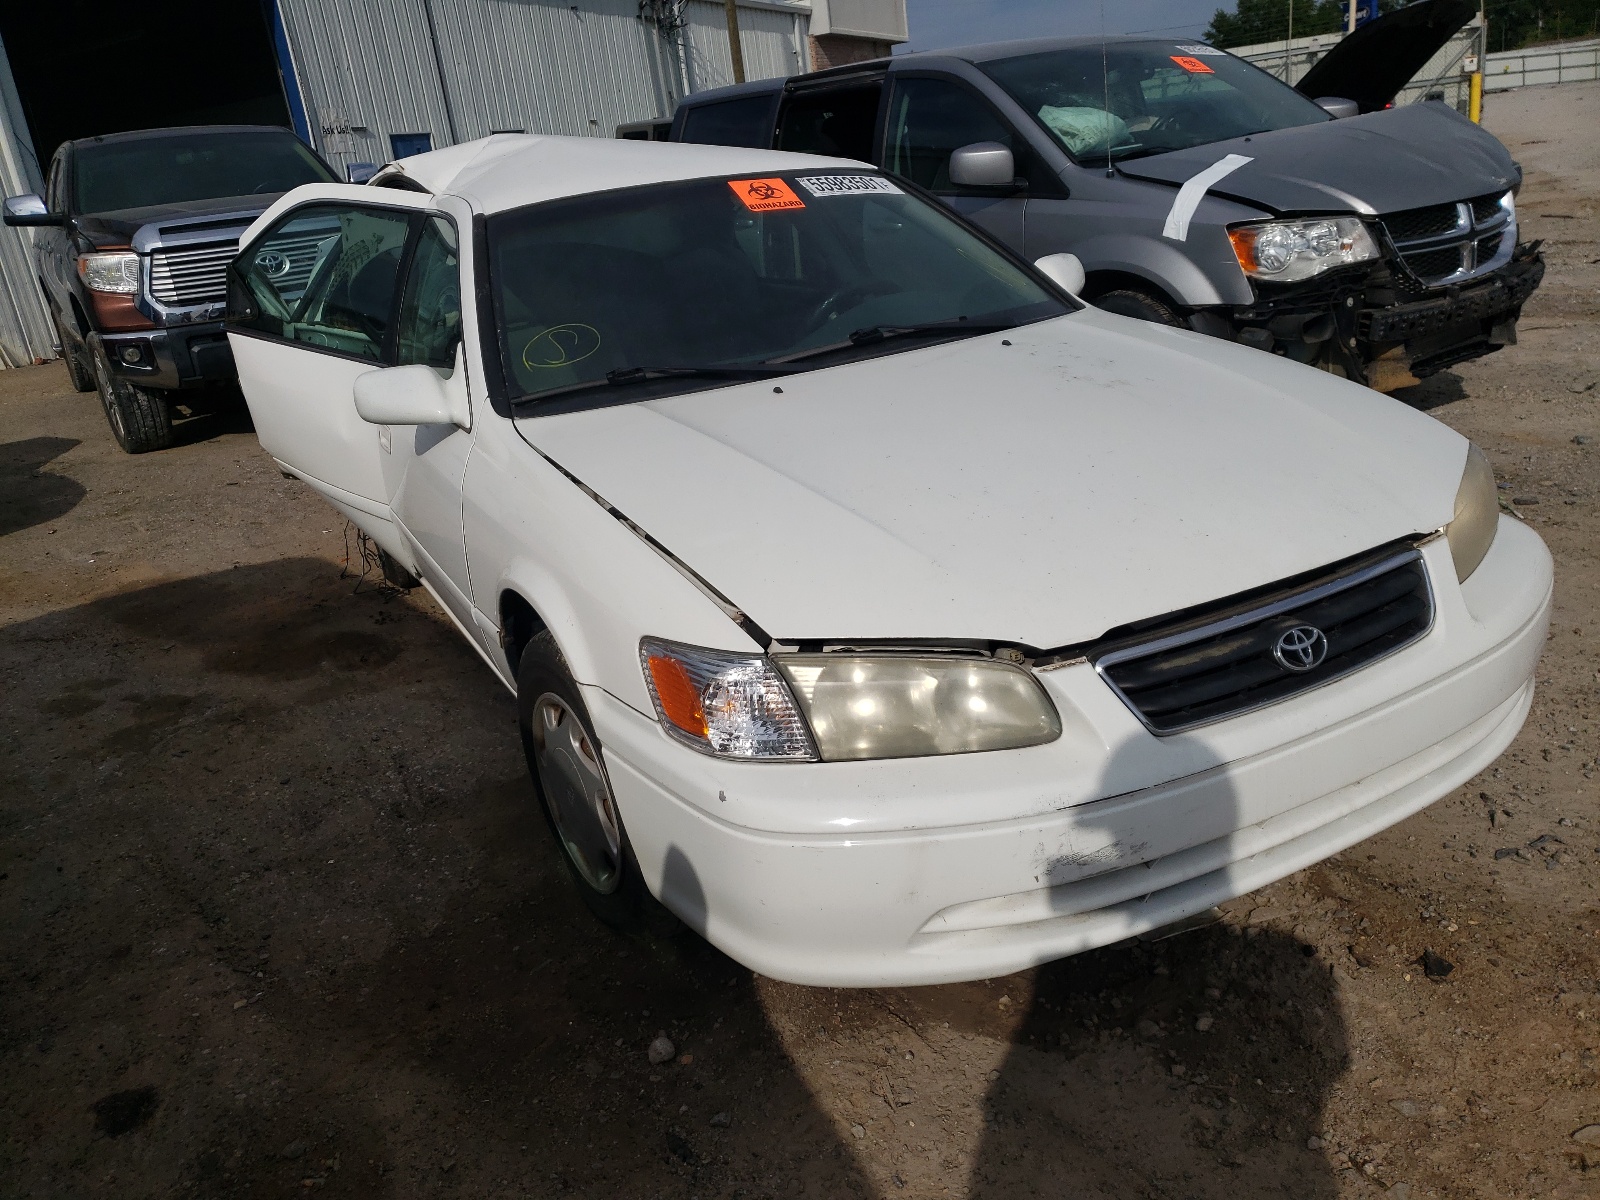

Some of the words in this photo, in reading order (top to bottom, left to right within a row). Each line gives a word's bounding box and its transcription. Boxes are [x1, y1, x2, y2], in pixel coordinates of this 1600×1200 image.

[322, 124, 335, 135] Ask
[806, 176, 886, 192] 55983501
[749, 200, 803, 210] BIOHAZARD
